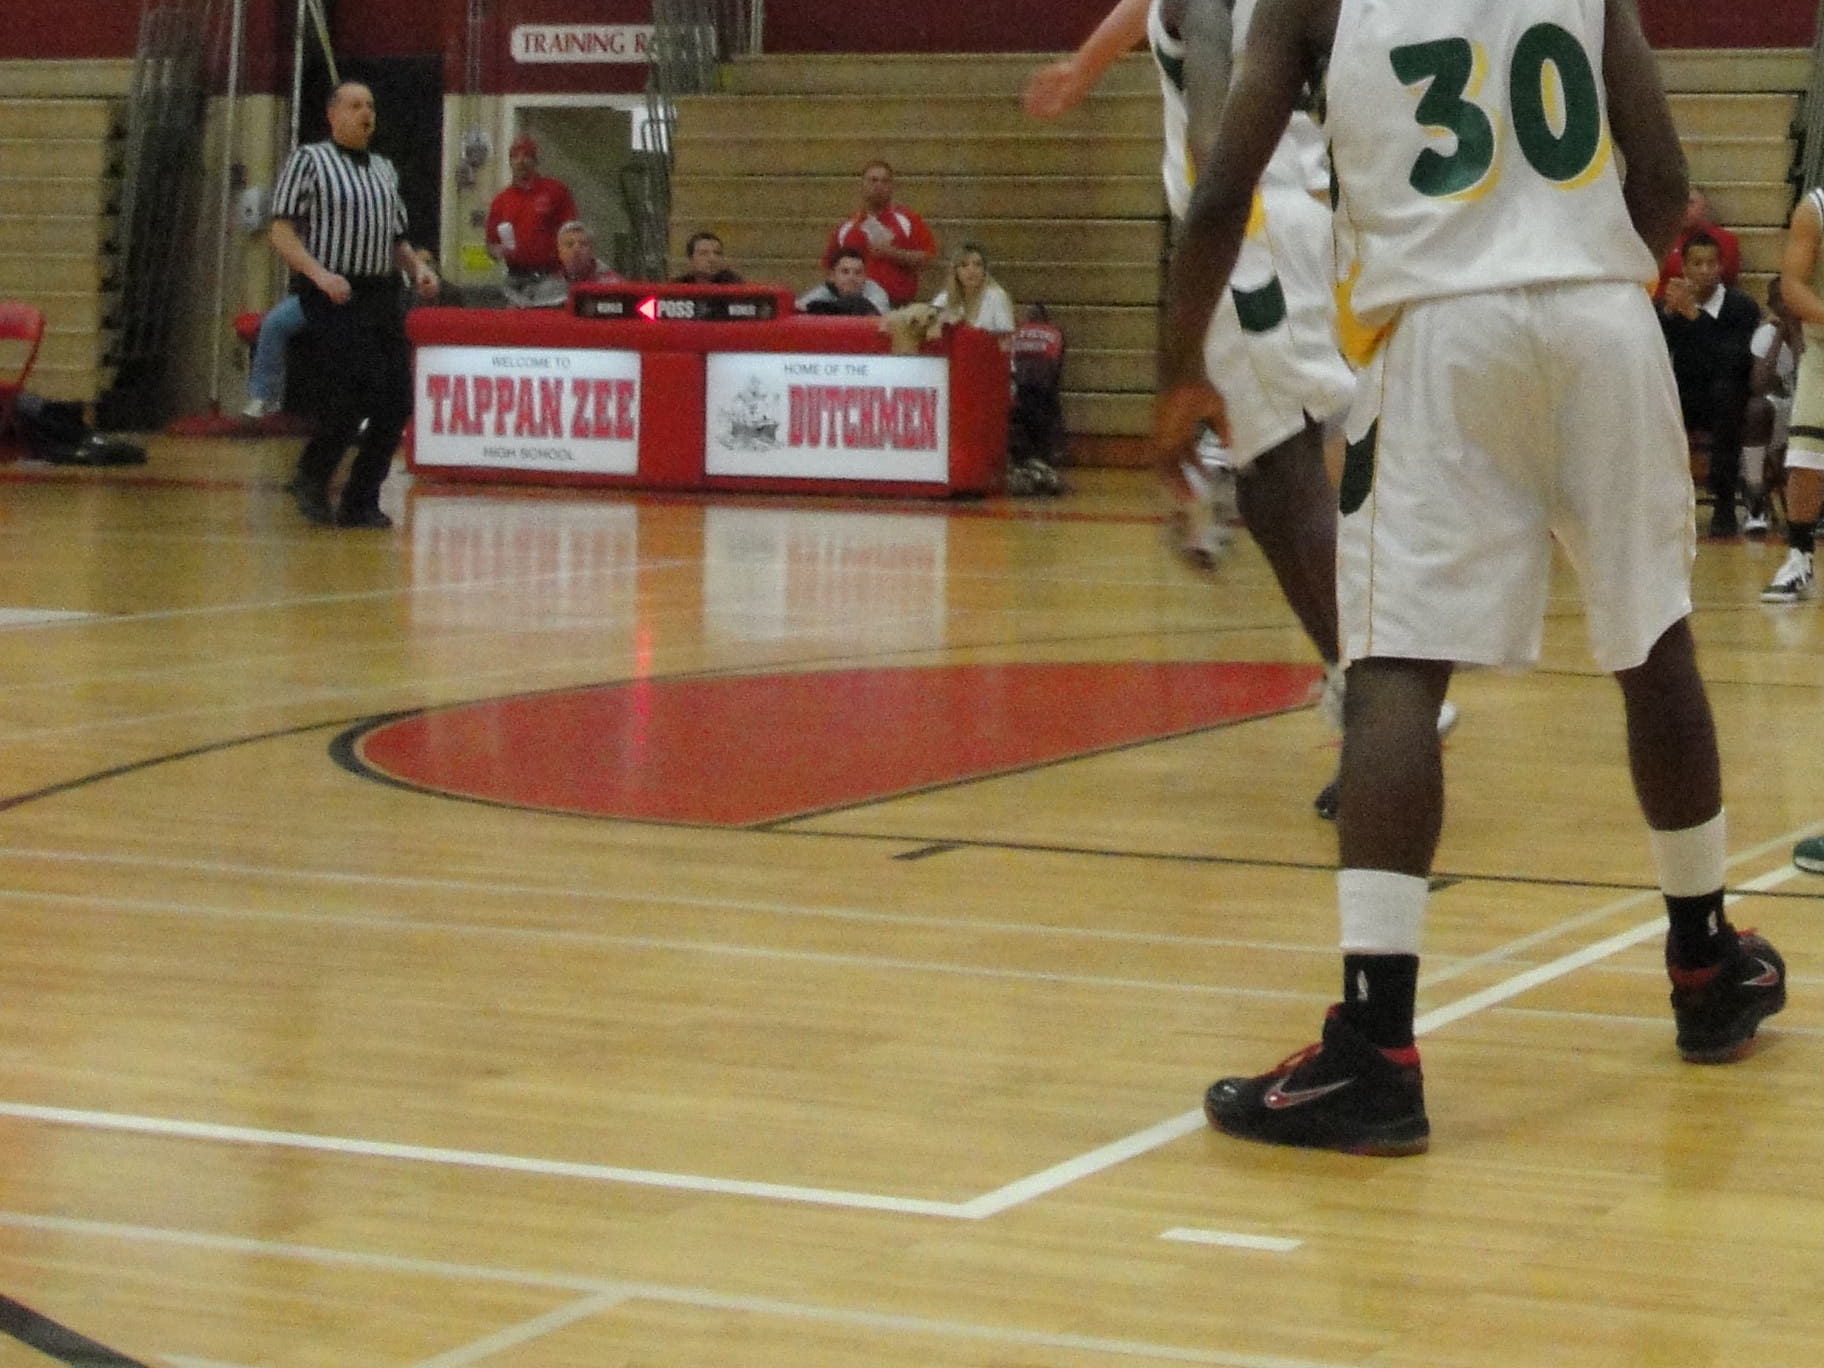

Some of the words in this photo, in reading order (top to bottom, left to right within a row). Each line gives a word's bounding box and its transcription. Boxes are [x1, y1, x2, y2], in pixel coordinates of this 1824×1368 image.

[521, 31, 626, 54] TRAINING
[1389, 21, 1610, 200] 30
[656, 299, 695, 319] POSS
[492, 355, 552, 370] WELCOME
[556, 356, 572, 371] TO
[784, 362, 819, 376] HOME
[822, 363, 841, 376] OF
[844, 363, 869, 377] THE
[427, 374, 565, 439] TAPPAN
[569, 376, 637, 441] ZEE
[788, 384, 940, 452] DUTCHMEN
[483, 447, 516, 461] HIGH
[519, 448, 575, 463] SCHOOL
